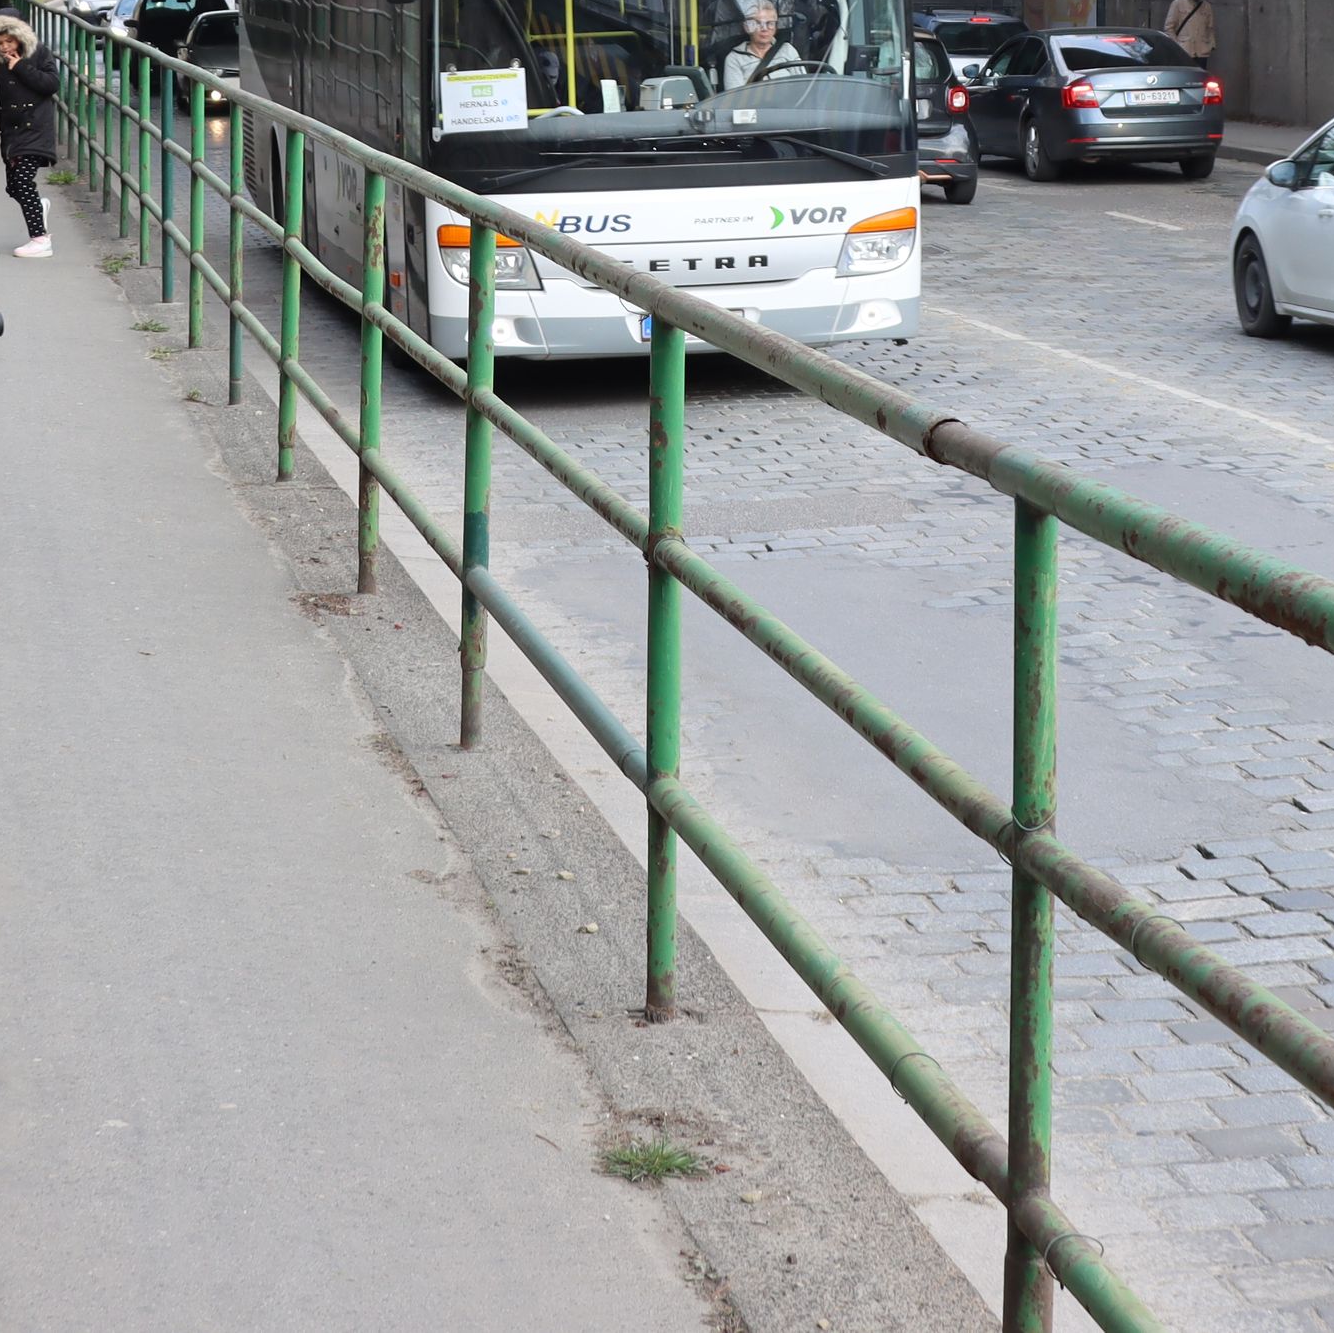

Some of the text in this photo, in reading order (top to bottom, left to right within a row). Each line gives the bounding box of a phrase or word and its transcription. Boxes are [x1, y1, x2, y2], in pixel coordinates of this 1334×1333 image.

[459, 99, 499, 108] HERNALS
[451, 116, 504, 126] HANDELSKAI
[789, 206, 847, 225] VOR
[694, 217, 740, 225] PARTNER
[620, 255, 769, 272] ETRA
